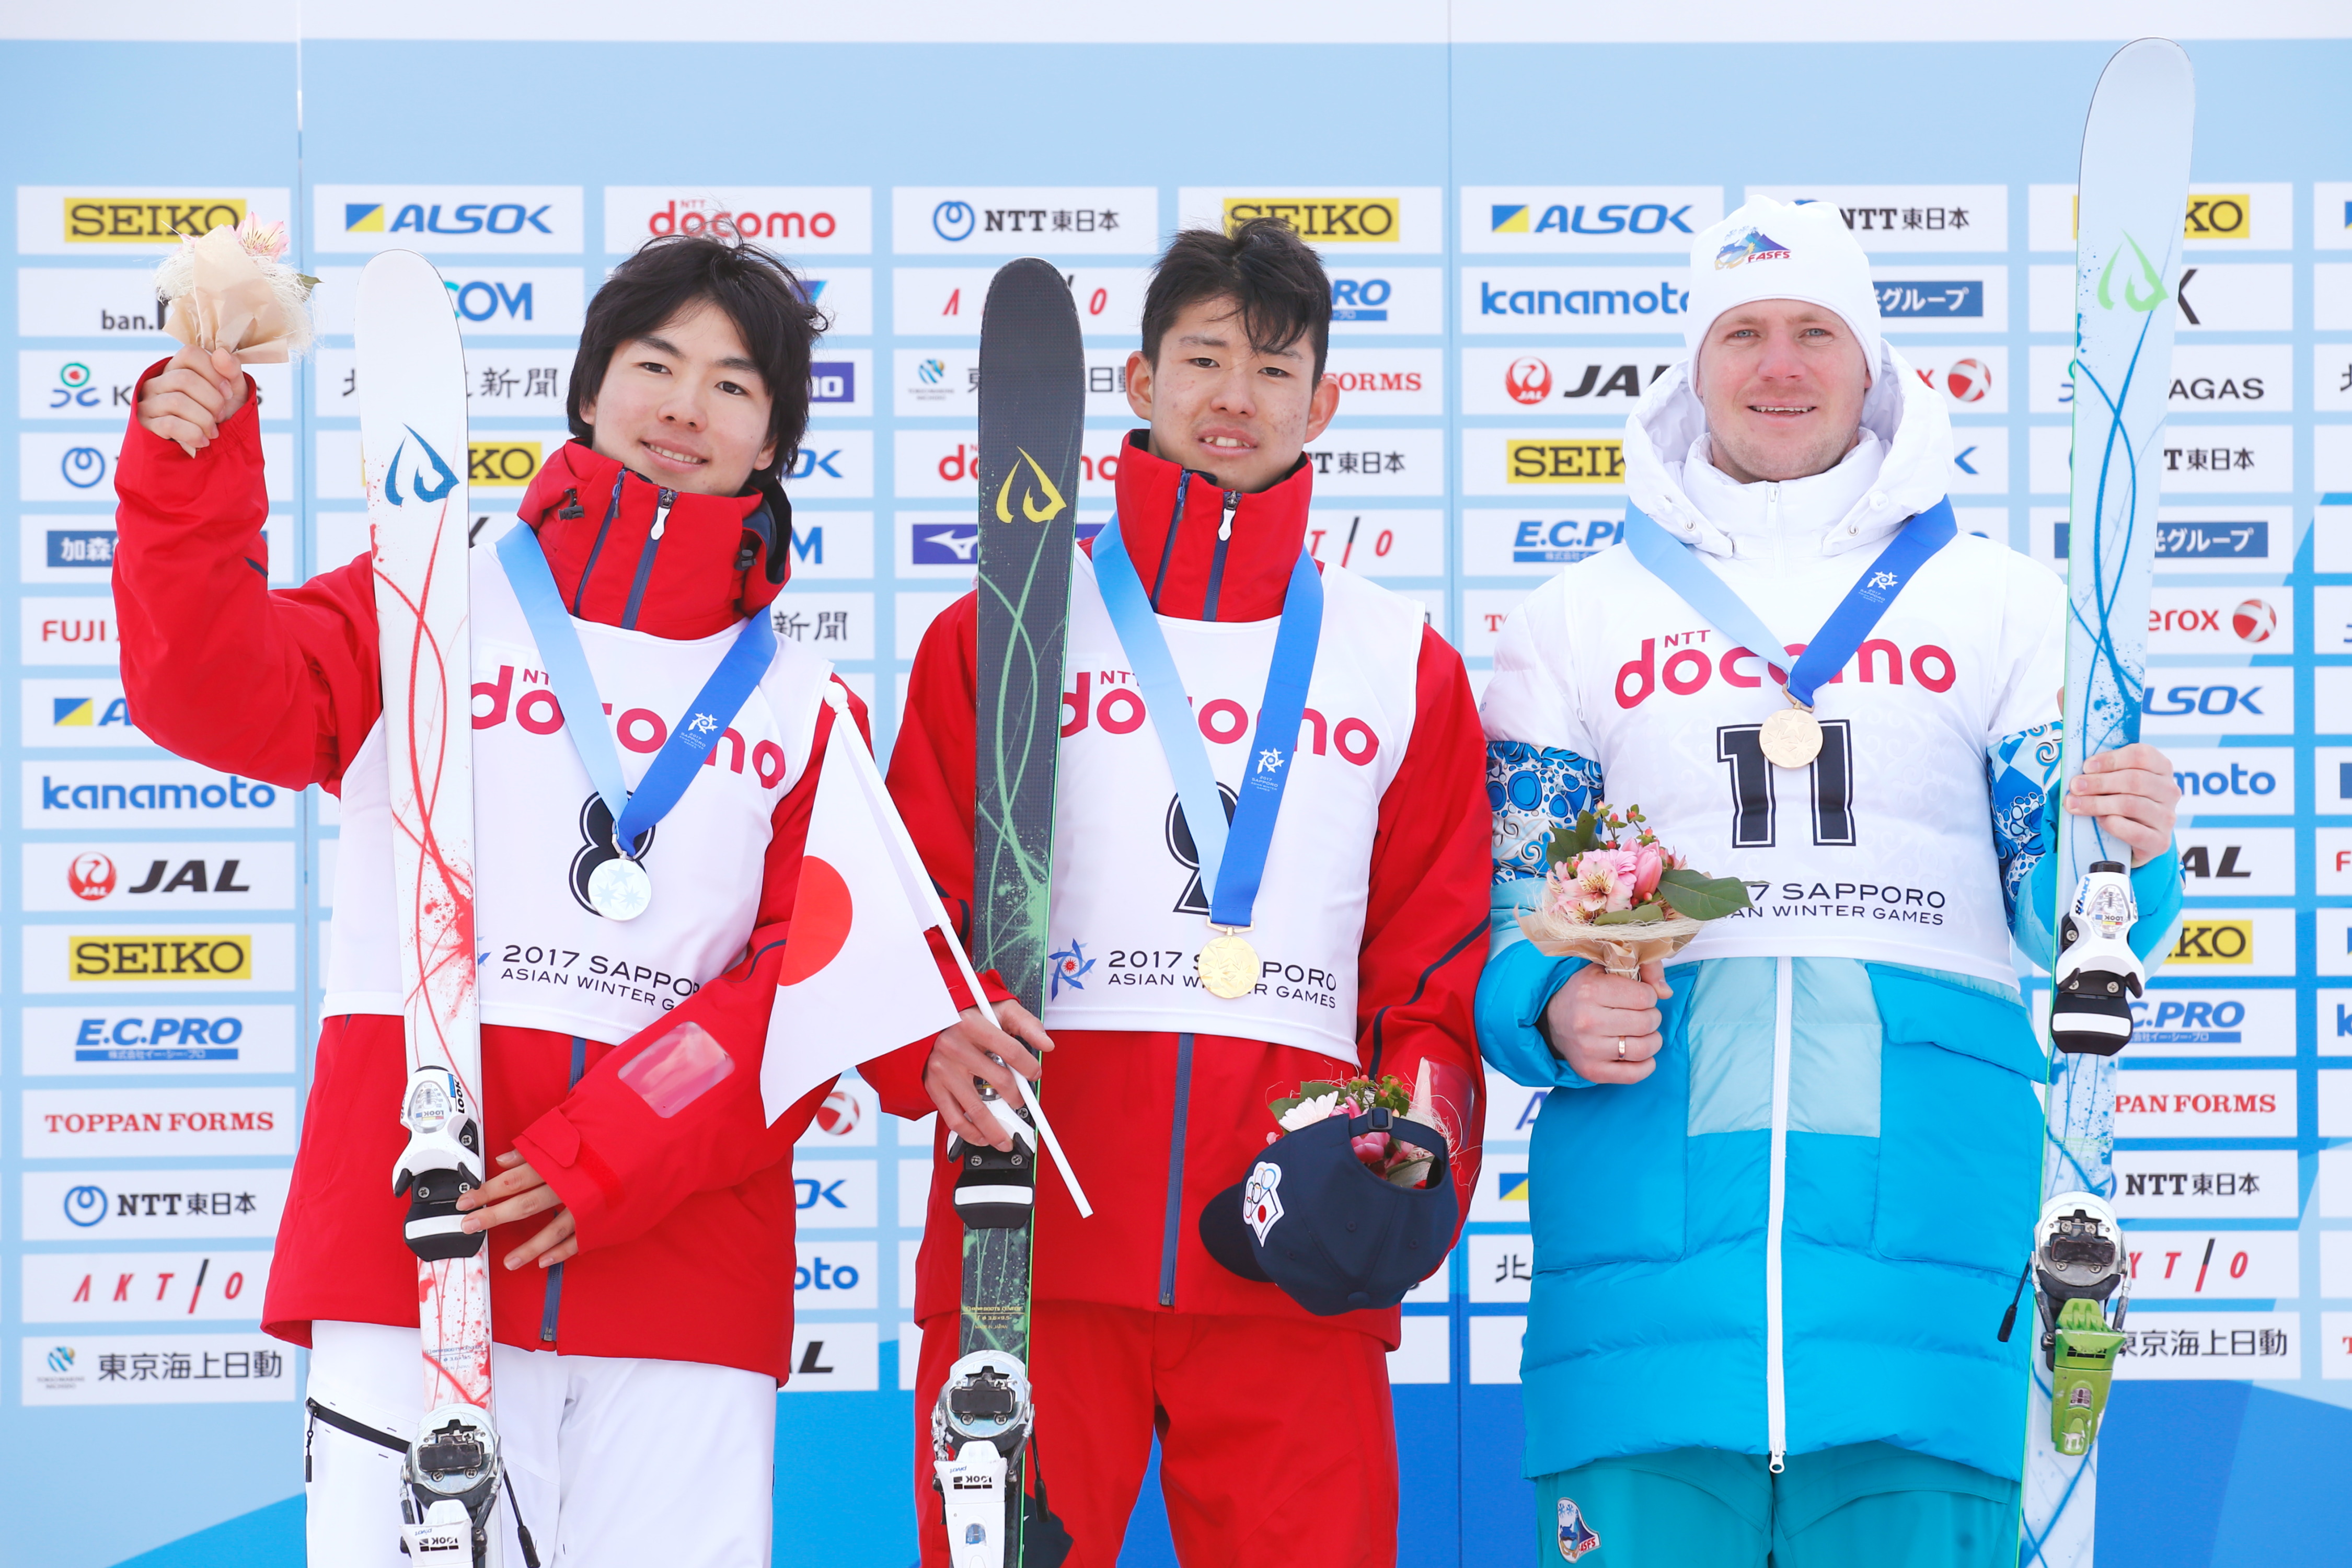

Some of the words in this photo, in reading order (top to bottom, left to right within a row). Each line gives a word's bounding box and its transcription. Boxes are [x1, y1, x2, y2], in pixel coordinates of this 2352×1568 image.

[72, 203, 240, 236] SEIKO
[389, 204, 554, 234] ALSOK
[1534, 204, 1694, 234] ALSOK
[1748, 251, 1791, 263] FASFS
[443, 282, 532, 321] OM
[1875, 287, 1969, 311] グループ
[42, 620, 103, 642] FUJI
[1664, 630, 1711, 648] NTT
[1100, 670, 1139, 686] NT
[681, 732, 706, 747] SAPPORO
[43, 776, 275, 809] kanamoto
[1251, 777, 1278, 788] SAPPORO
[1716, 719, 1857, 849] 11
[129, 860, 250, 893] JAL
[1782, 882, 1945, 908] SAPPORO
[1772, 905, 1865, 918] WINTER
[1873, 907, 1944, 926] GAMES
[76, 941, 244, 974] SEIKO
[502, 944, 580, 968] 2017
[1108, 950, 1183, 969] 2017
[501, 967, 569, 985] ASIAN
[577, 975, 656, 1007] WINTER
[1108, 973, 1174, 986] ASIAN
[1276, 986, 1336, 1009] GAMES
[76, 1017, 243, 1046] E.C.PRO
[454, 1078, 465, 1113] LOOK
[2174, 1094, 2276, 1113] FORMS
[45, 1113, 163, 1133] TOPPAN
[168, 1112, 274, 1131] FORMS
[98, 1351, 282, 1381] 東京海上日動
